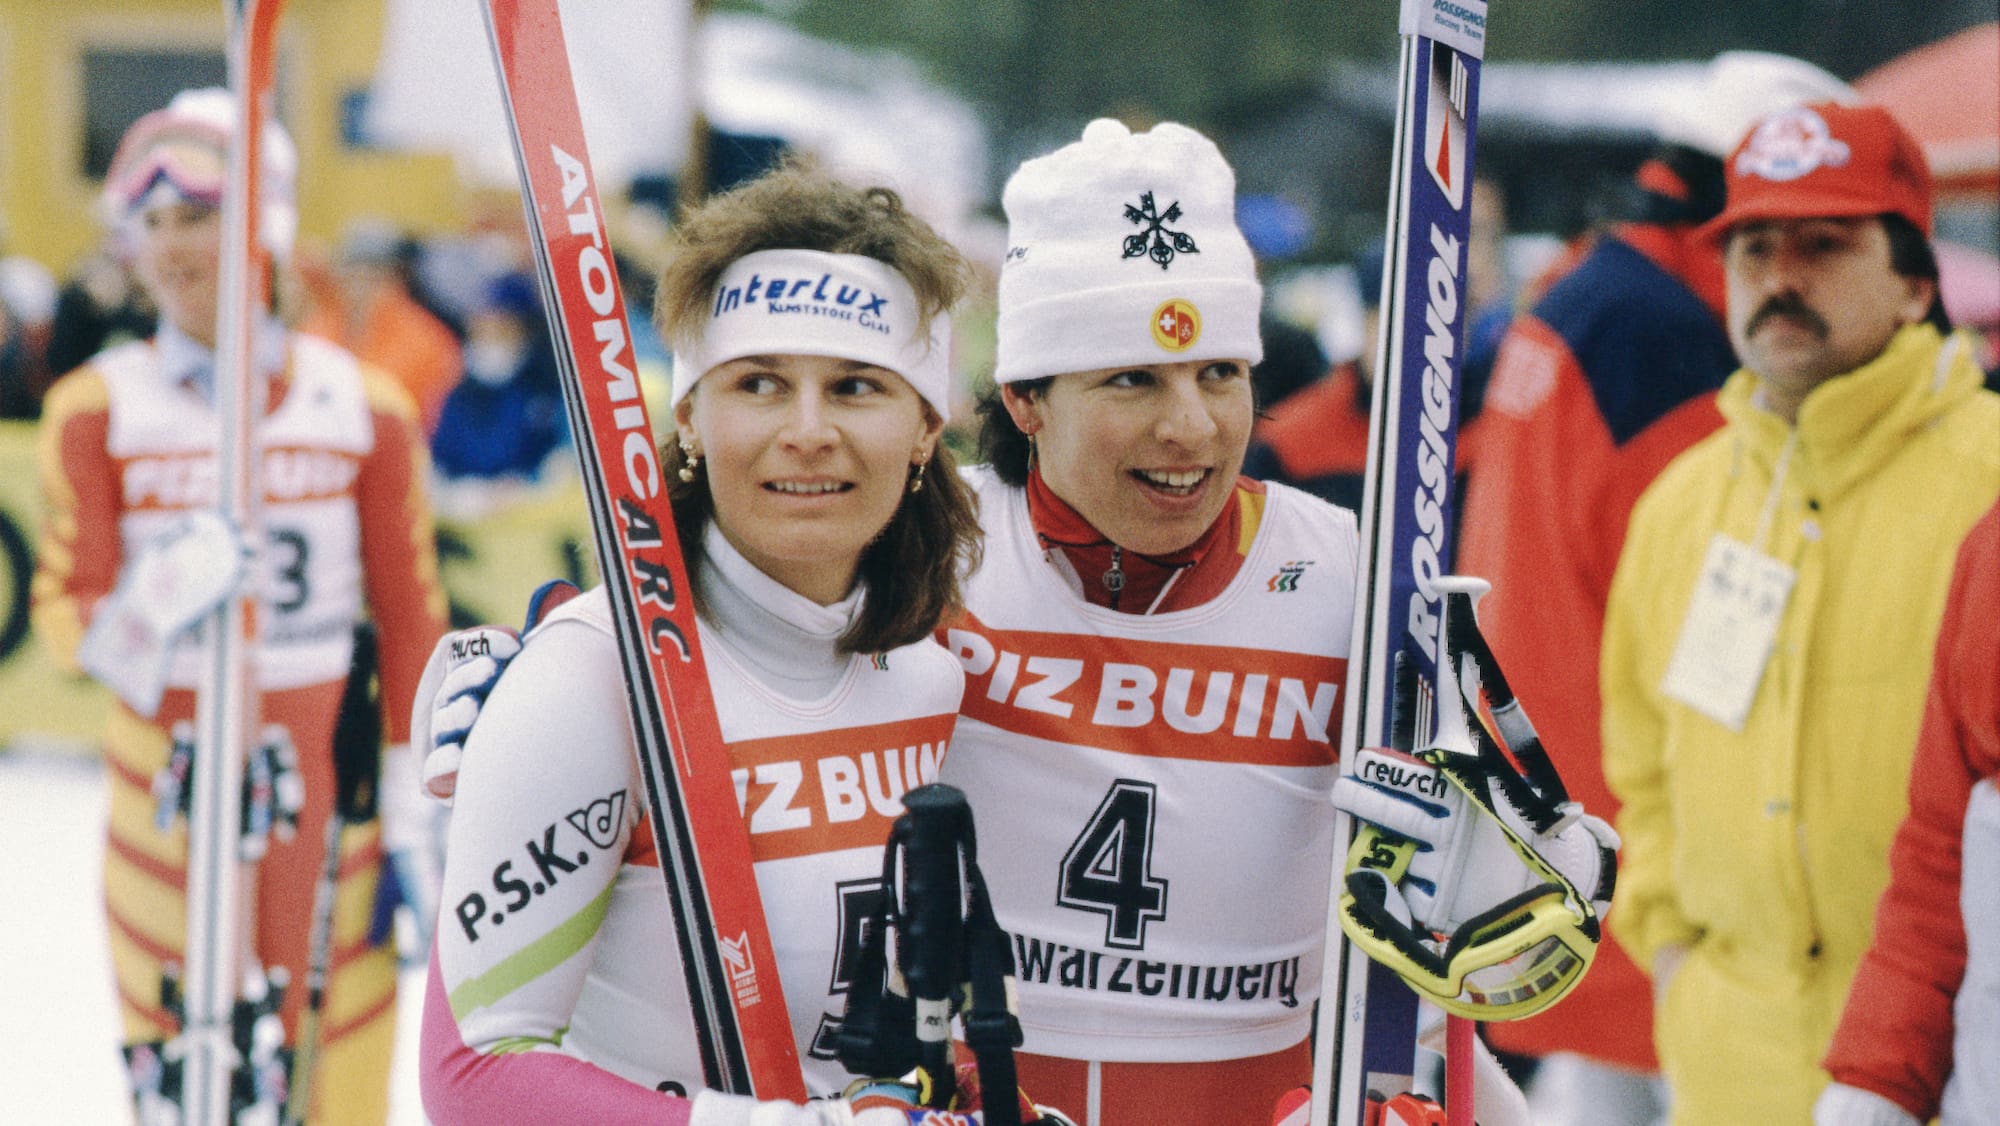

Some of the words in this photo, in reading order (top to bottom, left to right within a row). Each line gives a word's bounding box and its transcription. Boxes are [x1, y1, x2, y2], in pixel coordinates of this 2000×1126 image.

[550, 144, 659, 501] ATOMIC
[615, 496, 691, 664] ARC
[1407, 222, 1461, 664] ROSSIGNOL
[946, 628, 1084, 719] PIZ
[1091, 661, 1339, 745] BUIN
[1363, 760, 1449, 799] reusch
[456, 823, 590, 944] P.S.K.
[1056, 778, 1168, 950] 4
